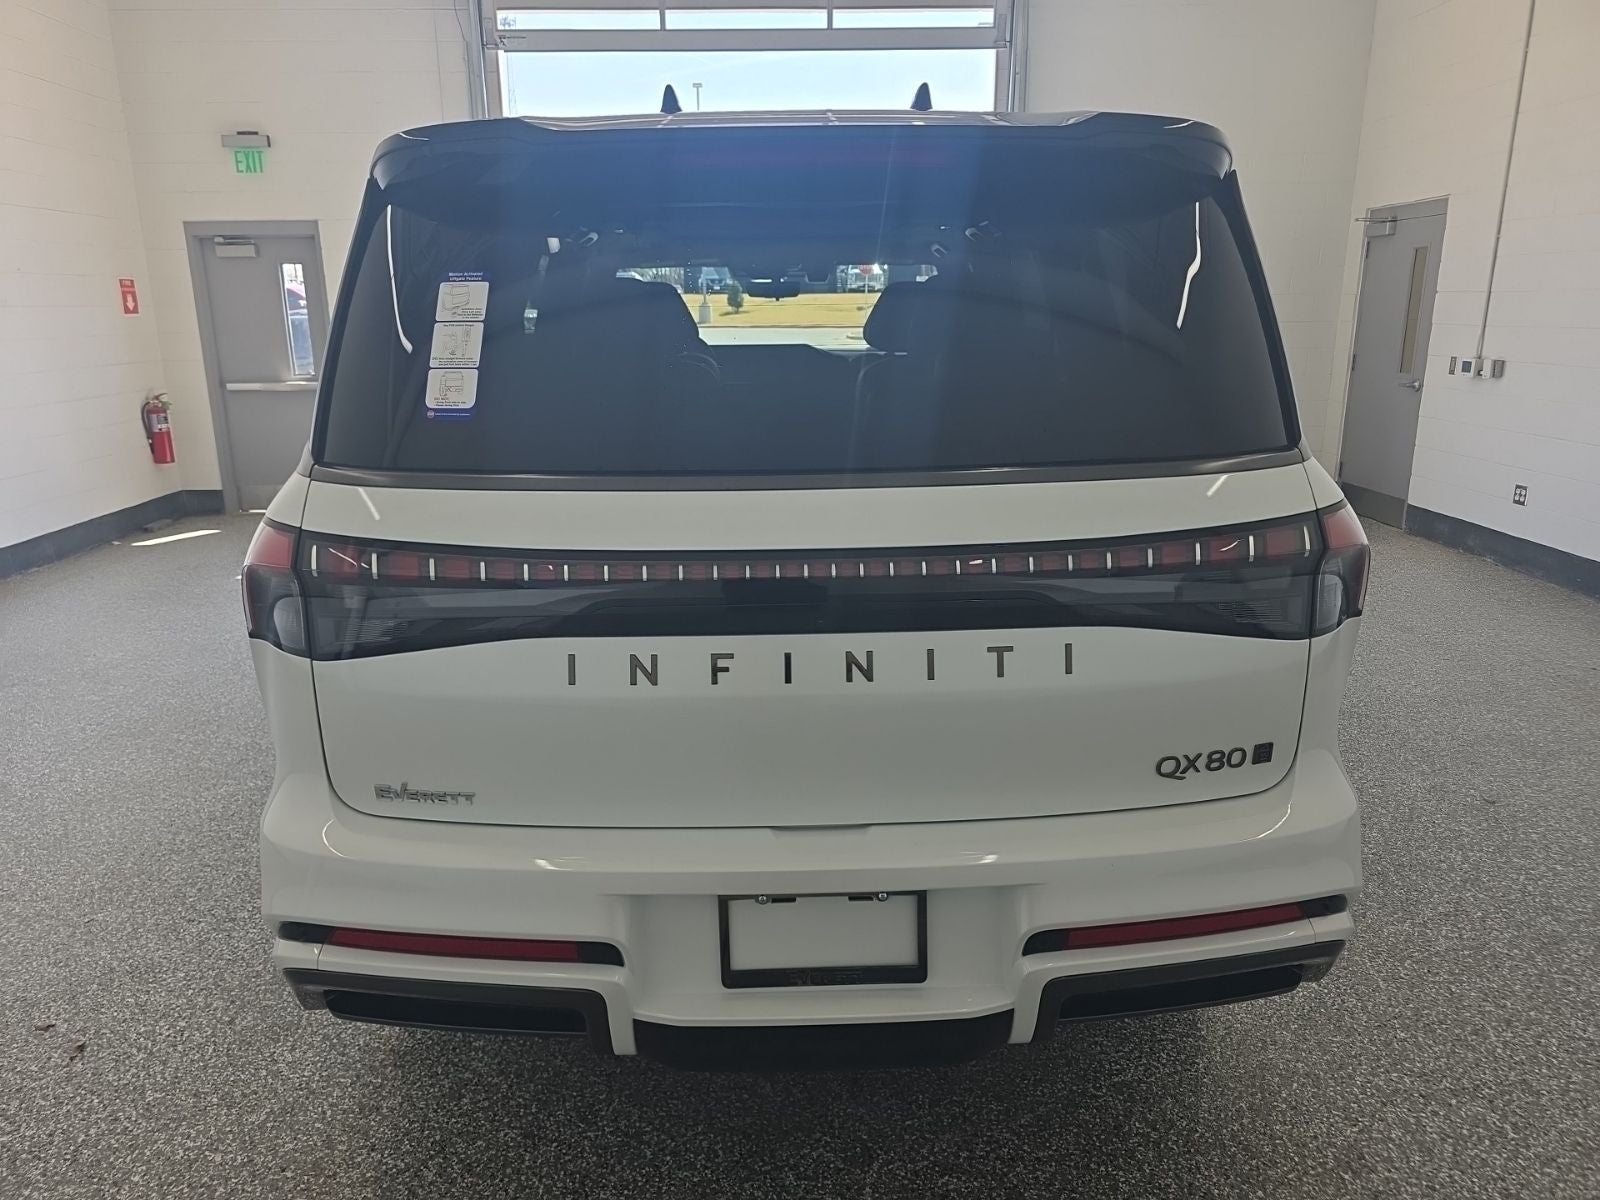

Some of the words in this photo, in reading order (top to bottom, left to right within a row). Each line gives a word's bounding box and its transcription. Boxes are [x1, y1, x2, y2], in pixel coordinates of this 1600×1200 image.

[234, 150, 264, 173] EXIT
[567, 643, 1073, 686] INFINITI
[1155, 747, 1247, 780] QX80
